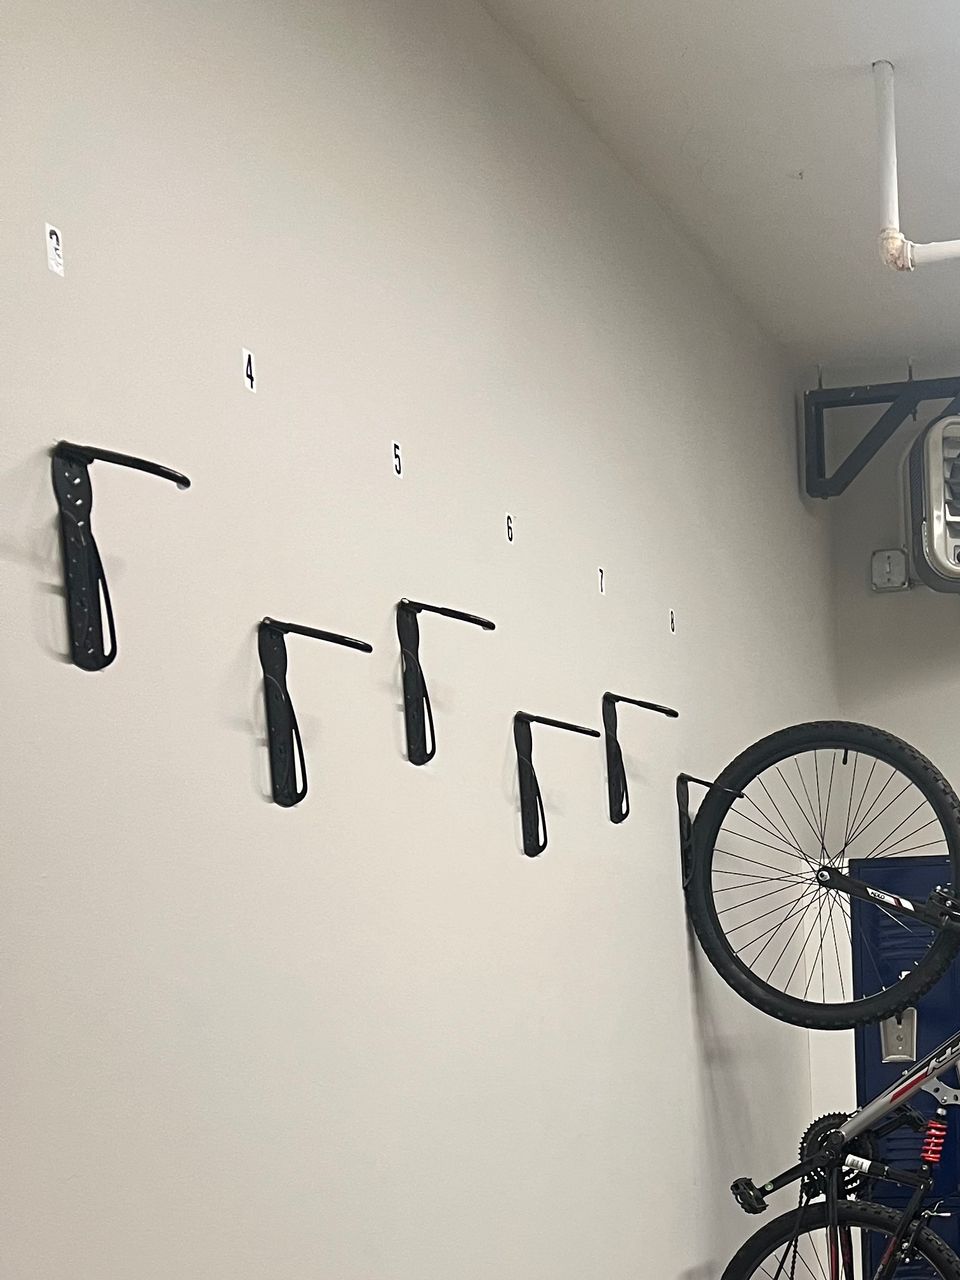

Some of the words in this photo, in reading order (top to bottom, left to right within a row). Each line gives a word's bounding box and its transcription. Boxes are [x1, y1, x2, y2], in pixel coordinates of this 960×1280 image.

[245, 353, 255, 389] 4
[393, 443, 402, 475] 5
[506, 515, 513, 542] 6
